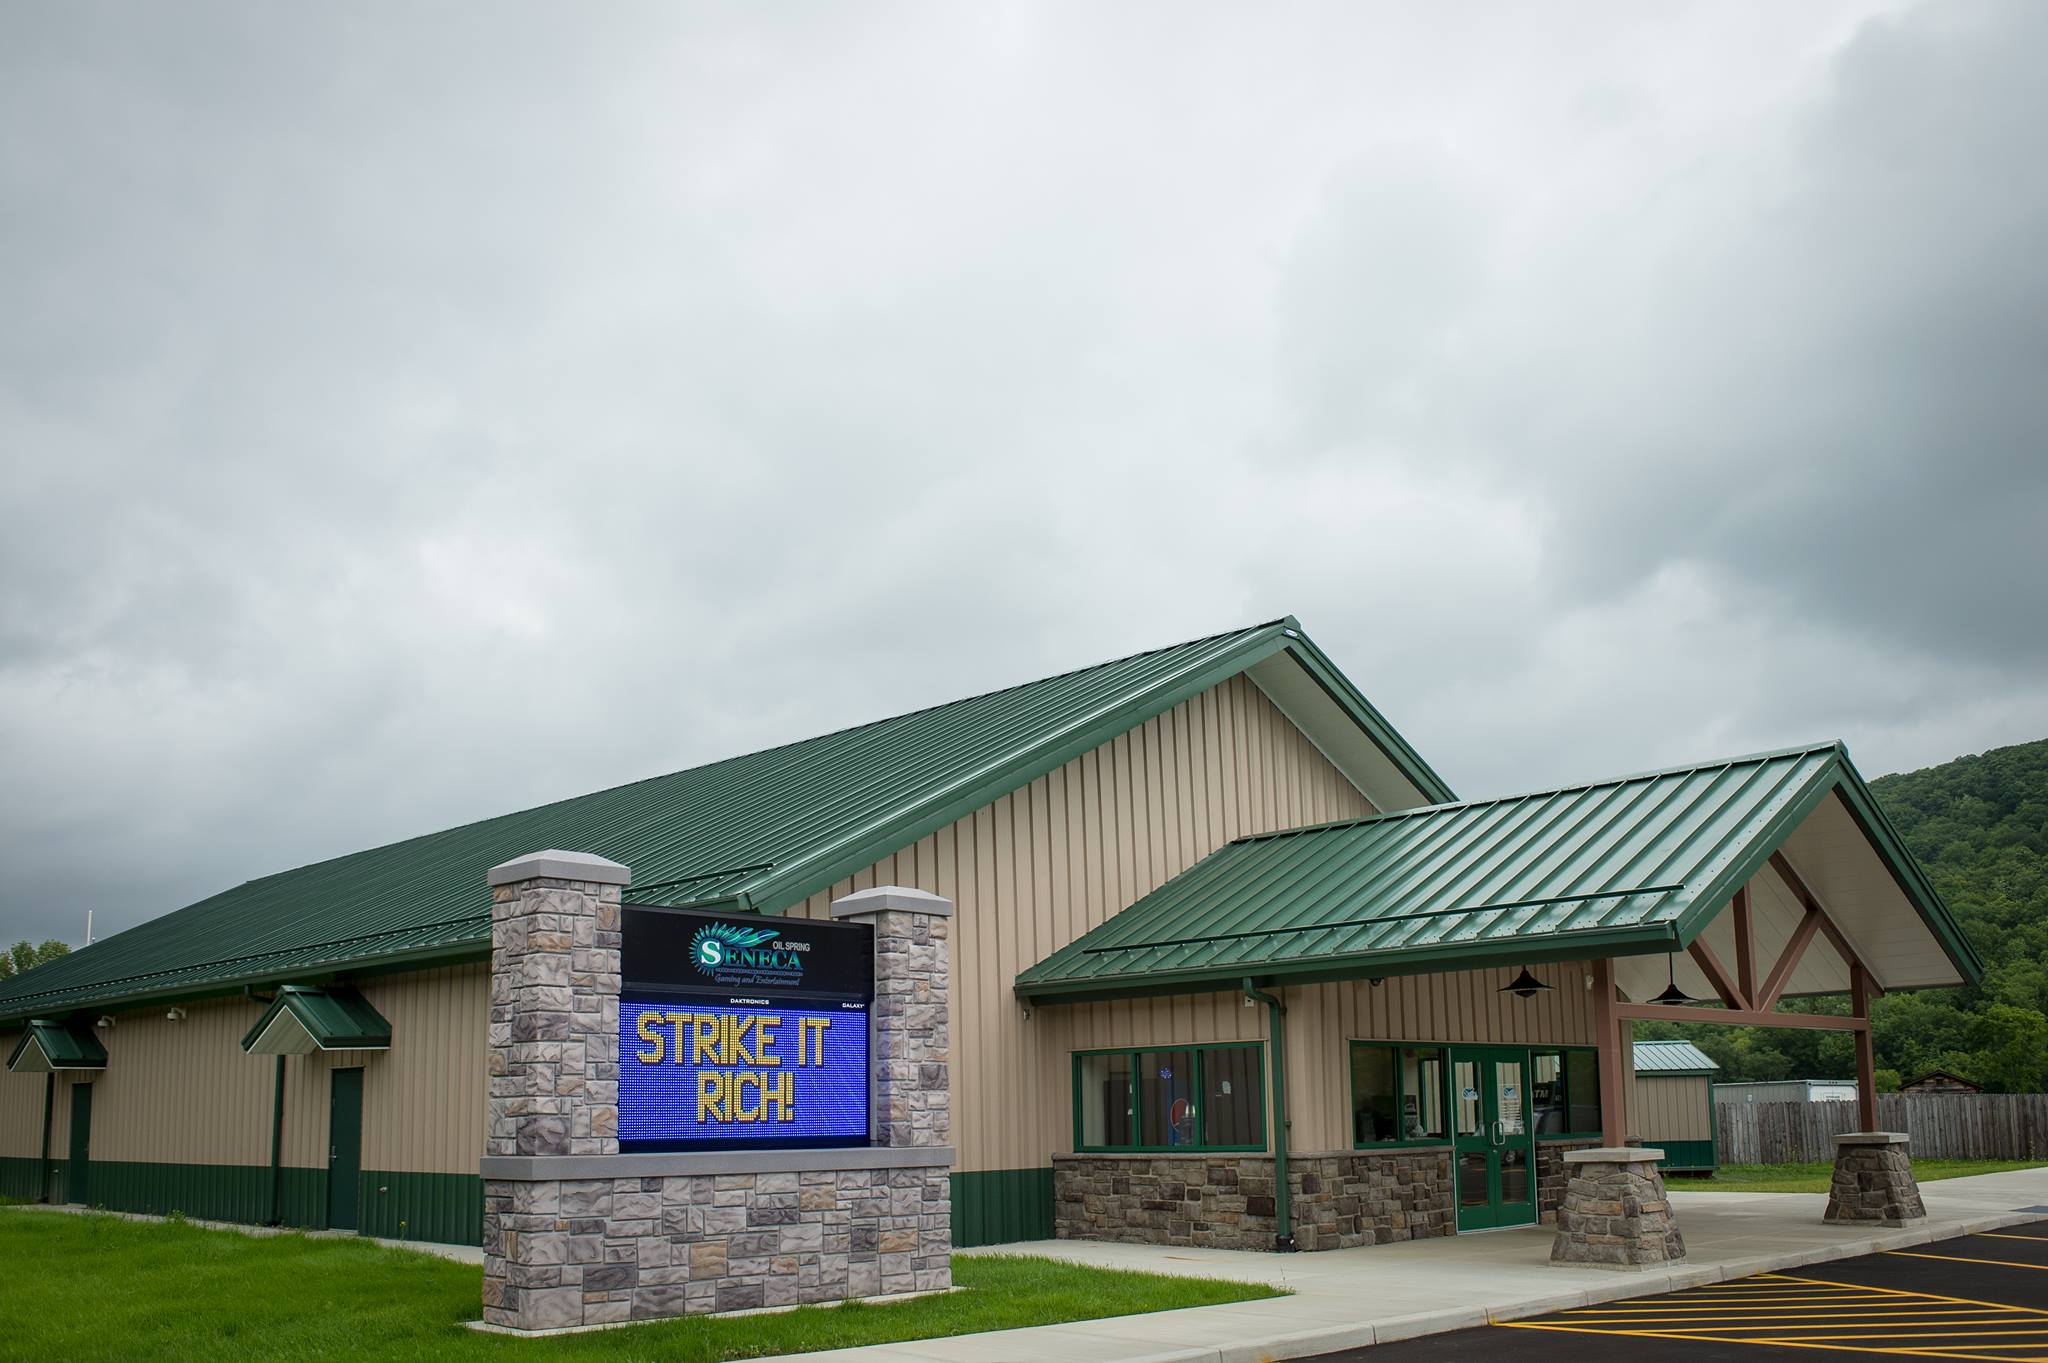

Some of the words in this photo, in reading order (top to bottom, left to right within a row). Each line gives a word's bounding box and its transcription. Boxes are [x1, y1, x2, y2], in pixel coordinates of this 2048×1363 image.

[701, 941, 804, 970] SENECA
[773, 940, 784, 950] OIL
[785, 941, 811, 952] SPRING
[715, 974, 740, 987] Gaming
[741, 975, 755, 983] and
[756, 976, 800, 986] Entertainment
[636, 1011, 781, 1066] STRIKE
[799, 1017, 831, 1066] IT
[697, 1071, 795, 1122] RICH!
